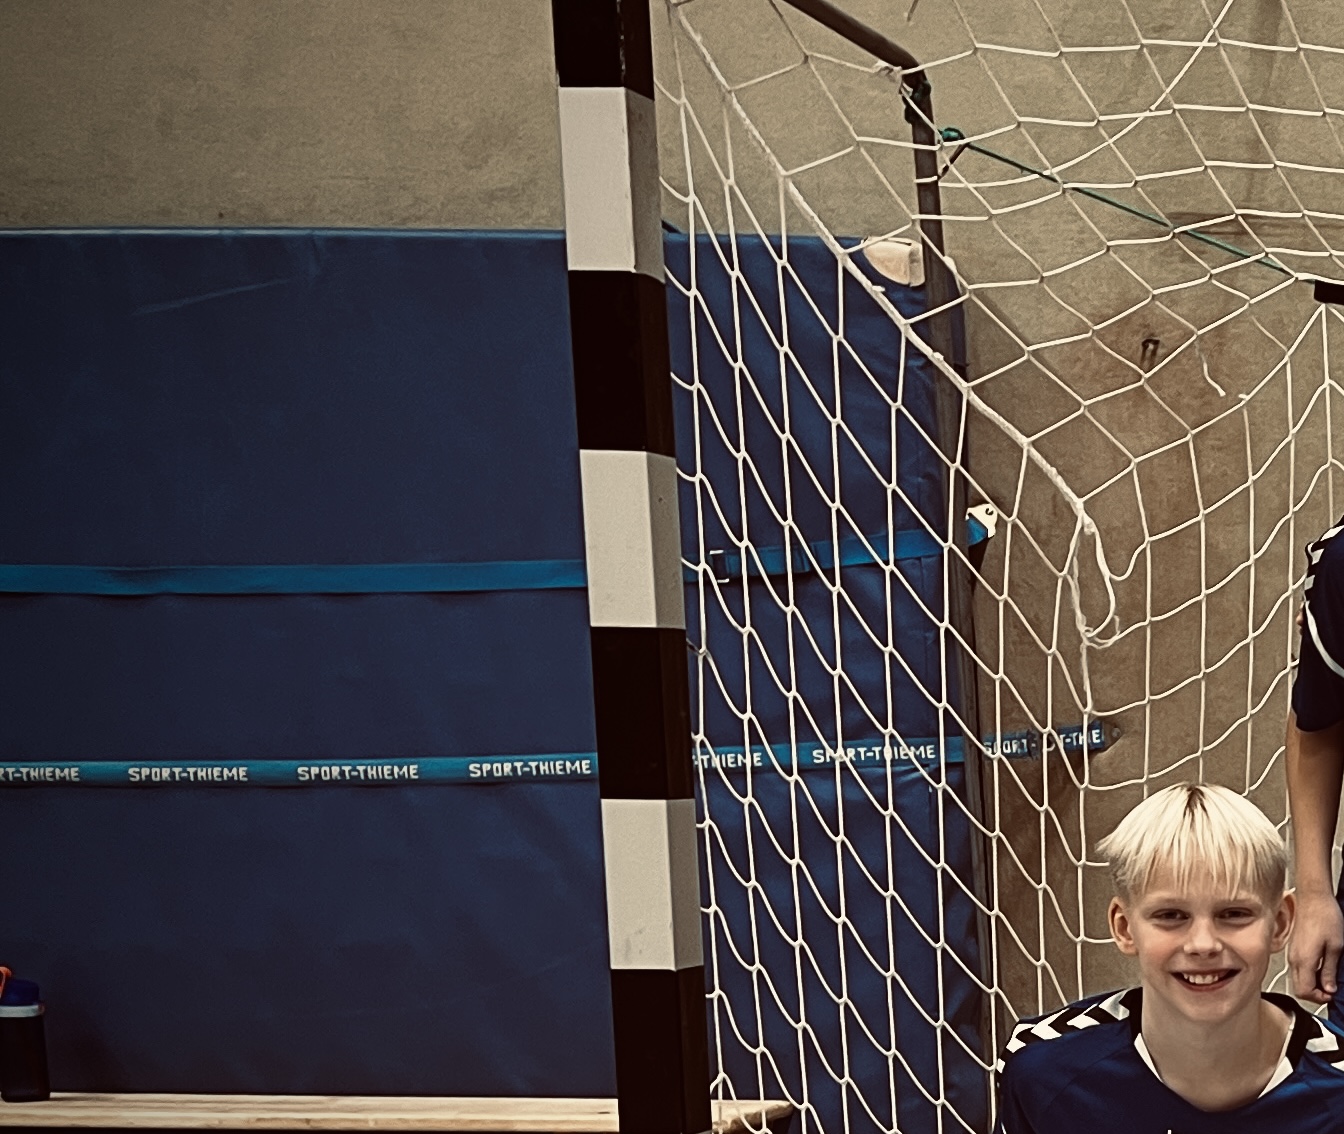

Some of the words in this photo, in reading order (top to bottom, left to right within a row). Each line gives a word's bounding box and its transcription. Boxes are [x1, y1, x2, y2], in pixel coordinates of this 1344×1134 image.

[128, 766, 248, 782] SPORT-THIEME
[297, 764, 419, 781] SPORT-THIEME
[468, 759, 592, 778] SPORT-THIEME
